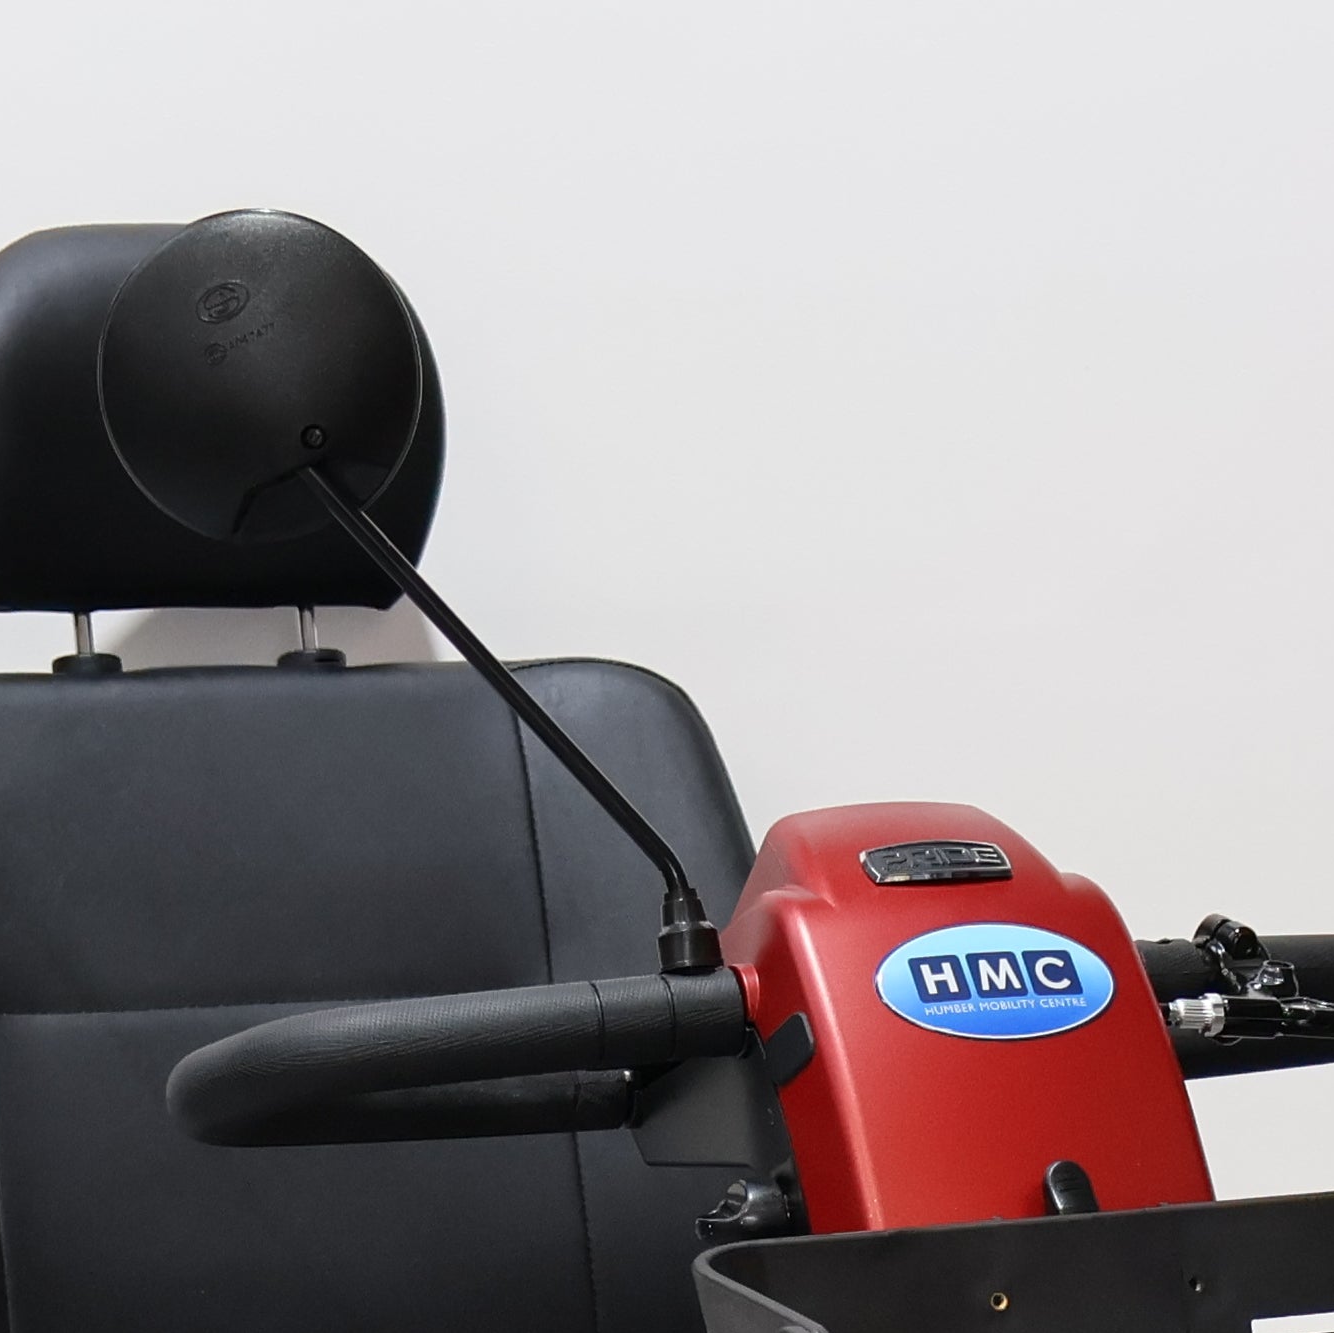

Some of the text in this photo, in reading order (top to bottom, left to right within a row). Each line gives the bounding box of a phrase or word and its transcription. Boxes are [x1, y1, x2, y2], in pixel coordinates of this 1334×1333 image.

[880, 846, 1002, 870] PRIDE
[919, 956, 1072, 996] HMC
[924, 997, 1087, 1016] HUMBER MOBILITY CENTRE
